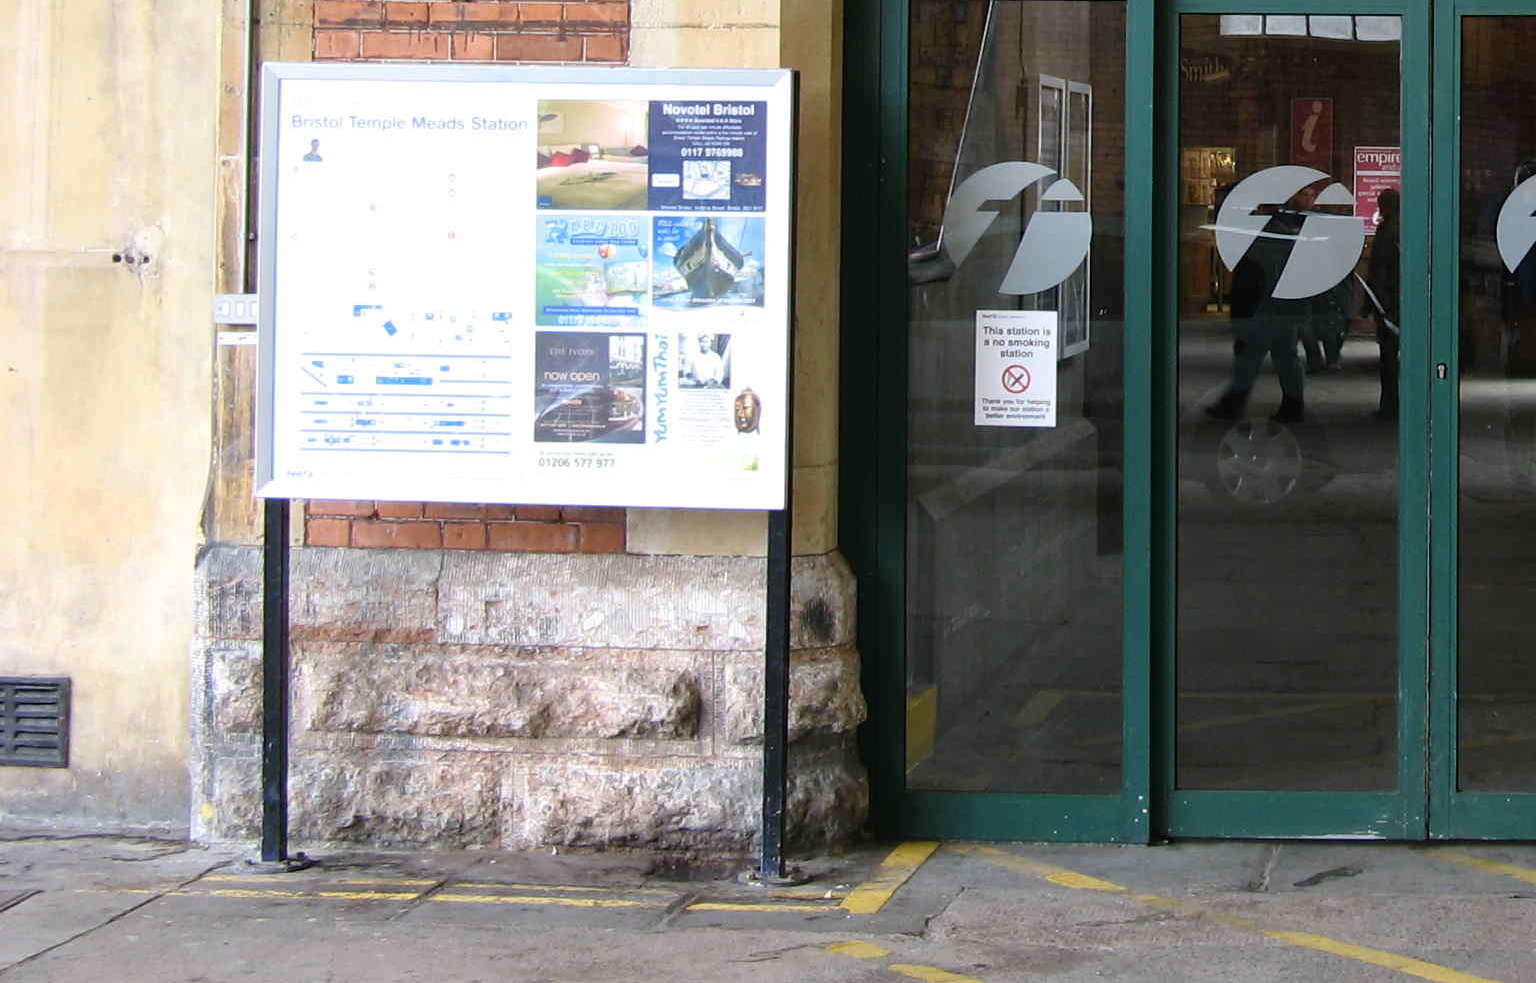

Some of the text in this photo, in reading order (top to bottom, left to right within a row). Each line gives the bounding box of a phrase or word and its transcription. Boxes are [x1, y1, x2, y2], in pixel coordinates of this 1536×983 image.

[662, 103, 755, 116] Novotel Bristol
[291, 115, 529, 131] Bristol Temple Meads Station
[984, 326, 1052, 336] This station is
[992, 338, 1006, 347] no
[1008, 337, 1050, 349] smoking
[1000, 349, 1034, 359] station
[544, 371, 601, 383] now open
[538, 457, 571, 468] 01206
[573, 458, 593, 468] 577
